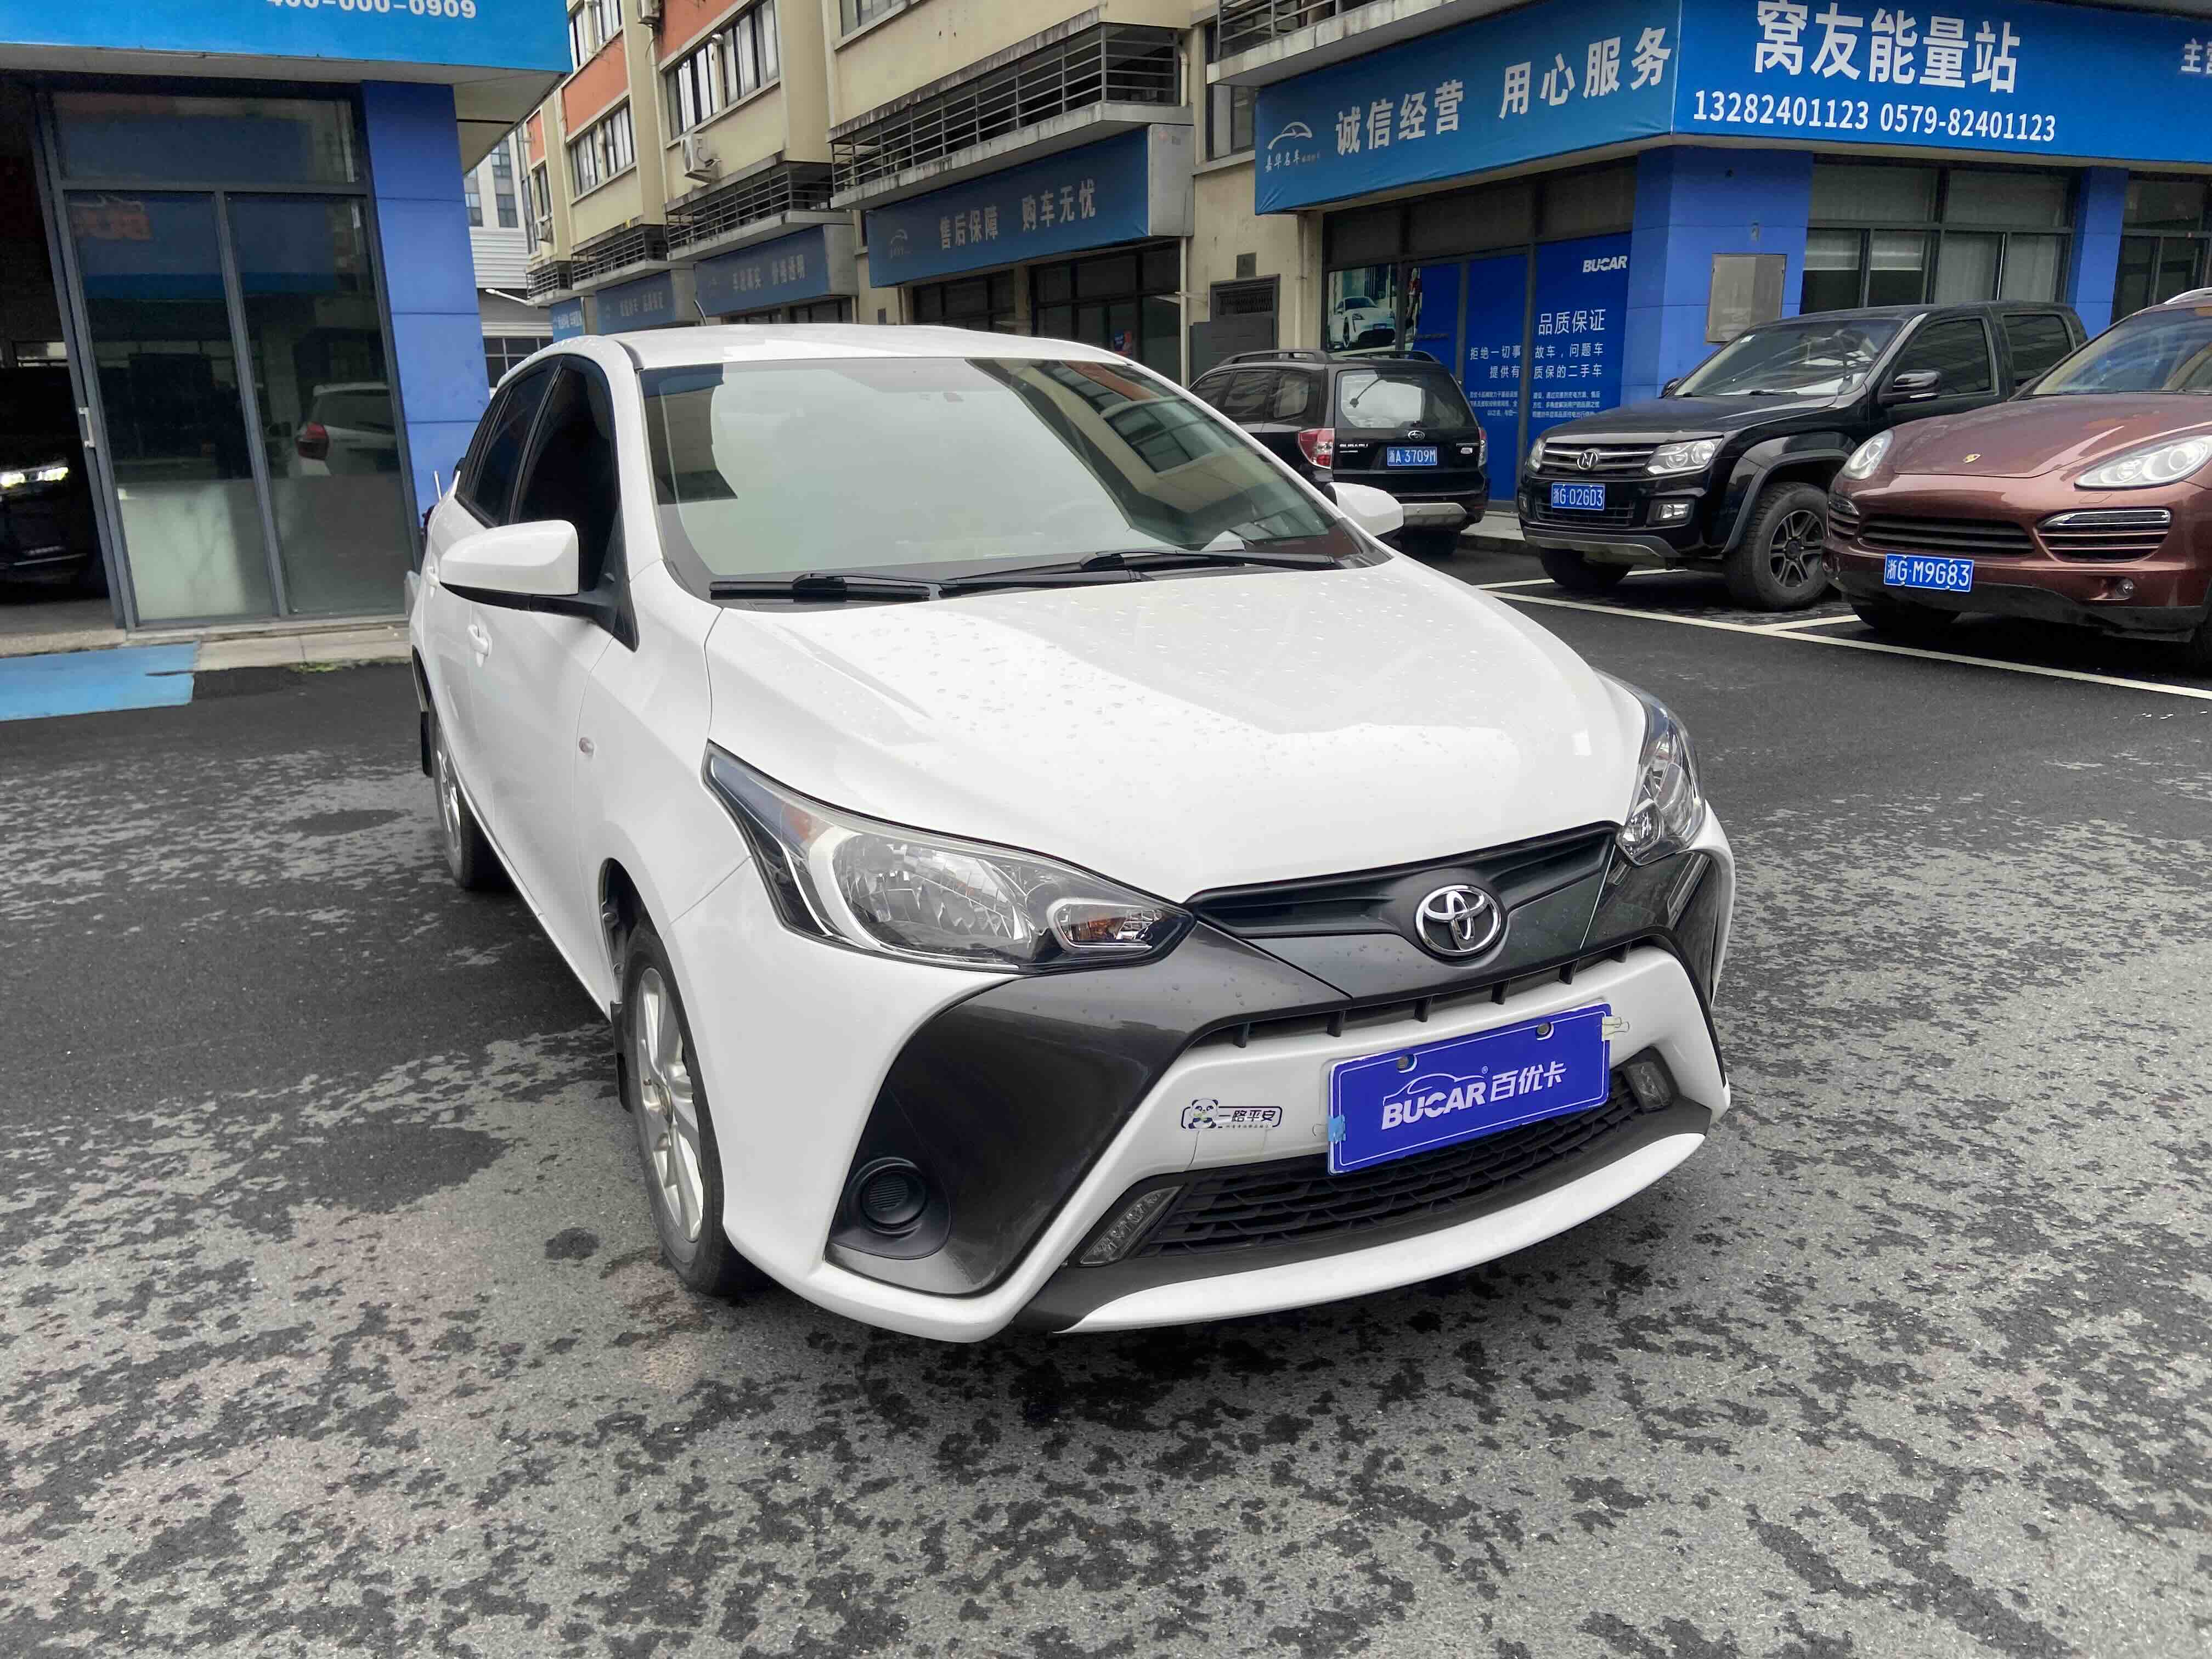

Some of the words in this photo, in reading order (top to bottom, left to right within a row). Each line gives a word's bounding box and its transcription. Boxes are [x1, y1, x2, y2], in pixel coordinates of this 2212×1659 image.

[1754, 0, 2021, 93] 窝友能量站
[2181, 37, 2212, 75] 主
[1335, 78, 1464, 156] 诚信经营
[1499, 27, 1671, 119] 用心服务
[1693, 91, 1868, 130] 13282401123
[1880, 103, 2056, 142] 0579-82401123
[940, 204, 998, 250] 售后保障
[1022, 178, 1096, 233] 购车无忧
[1582, 255, 1628, 273] BUCAR
[1538, 309, 1606, 336] 品质保证
[1470, 345, 1521, 360] 拒绝一切事
[1489, 365, 1520, 379] 提供有
[1533, 363, 1602, 379] 质保的二手车
[1381, 1082, 1486, 1130] BUCAR
[1490, 1060, 1567, 1103] 百优卡
[1218, 1110, 1276, 1122] 一路平安
